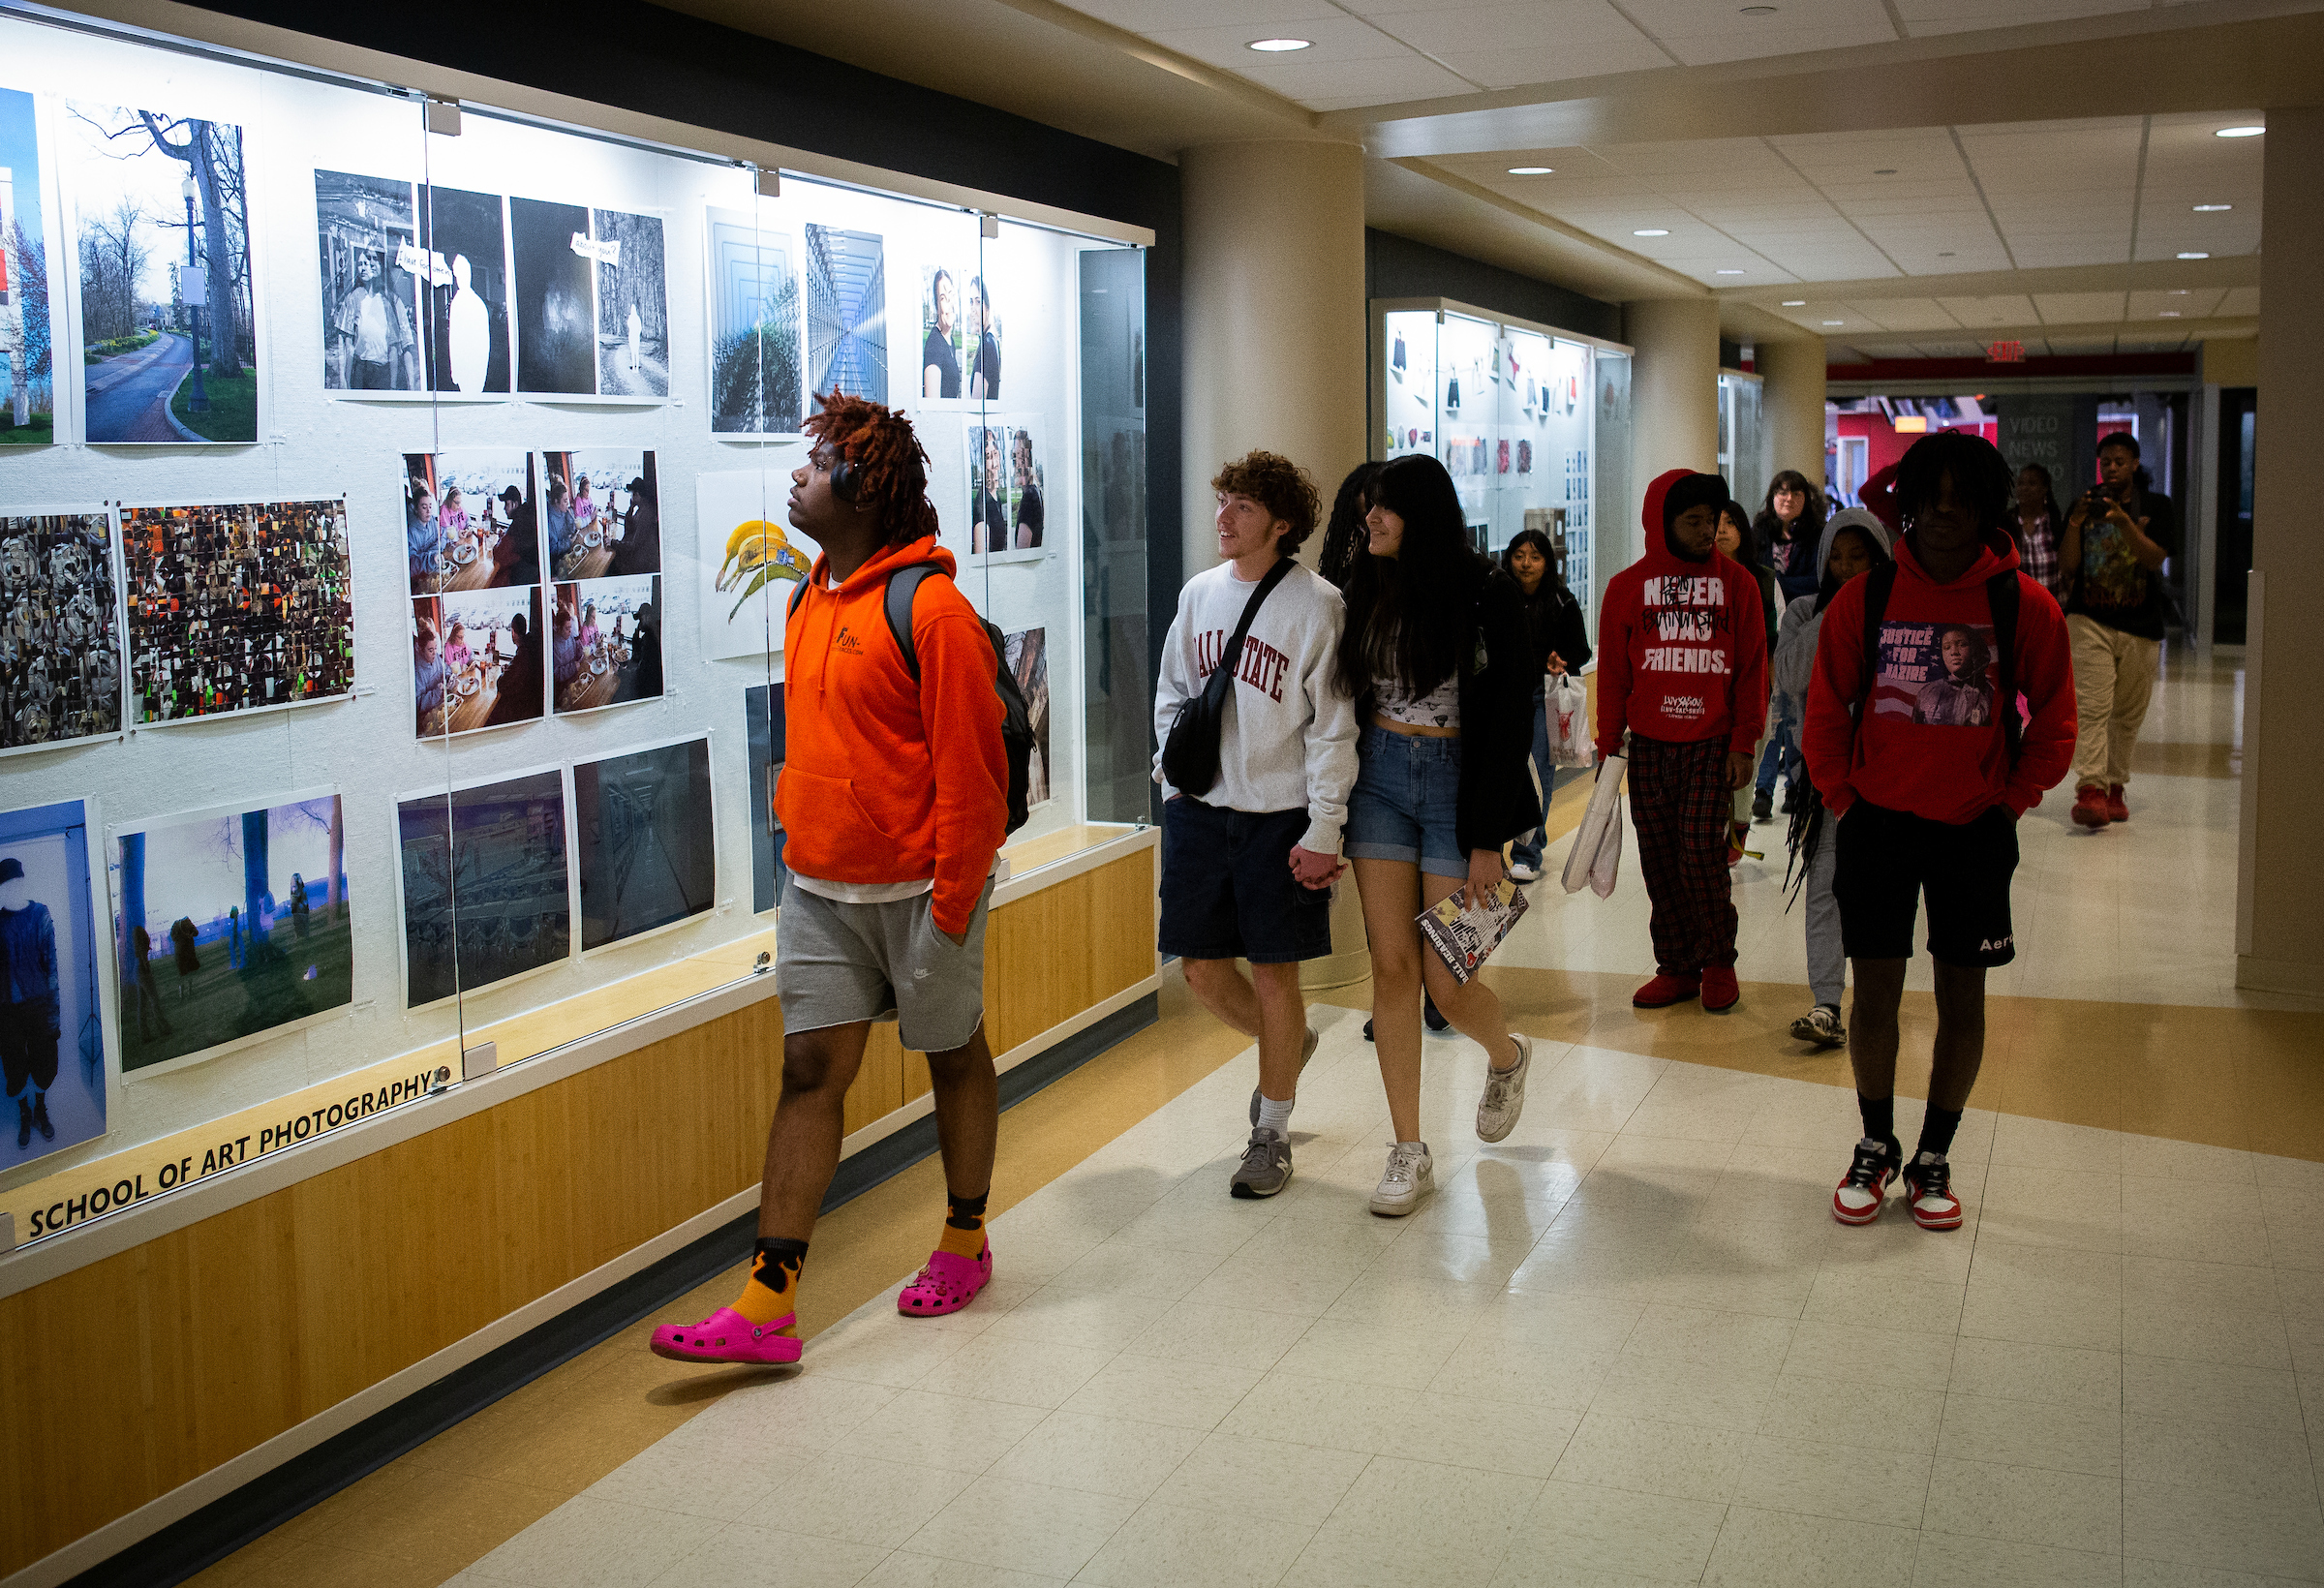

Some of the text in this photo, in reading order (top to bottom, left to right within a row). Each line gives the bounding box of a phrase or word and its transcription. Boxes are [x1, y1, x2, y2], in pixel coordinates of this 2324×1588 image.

[419, 259, 451, 278] forotten
[2009, 416, 2059, 434] VIDEO
[2008, 441, 2059, 457] NEWS
[1644, 575, 1725, 606] NEVER
[1657, 611, 1713, 642] WAS
[1880, 628, 1935, 646] JUSTICE
[1194, 629, 1224, 679] ALL
[1641, 647, 1731, 675] FRIENDS.
[1892, 647, 1917, 663] FOR
[1420, 918, 1456, 964] BEARINGS
[1452, 962, 1470, 984] BALL
[30, 1070, 432, 1237] SCHOOL OF ART PHOTOGRAPHY
